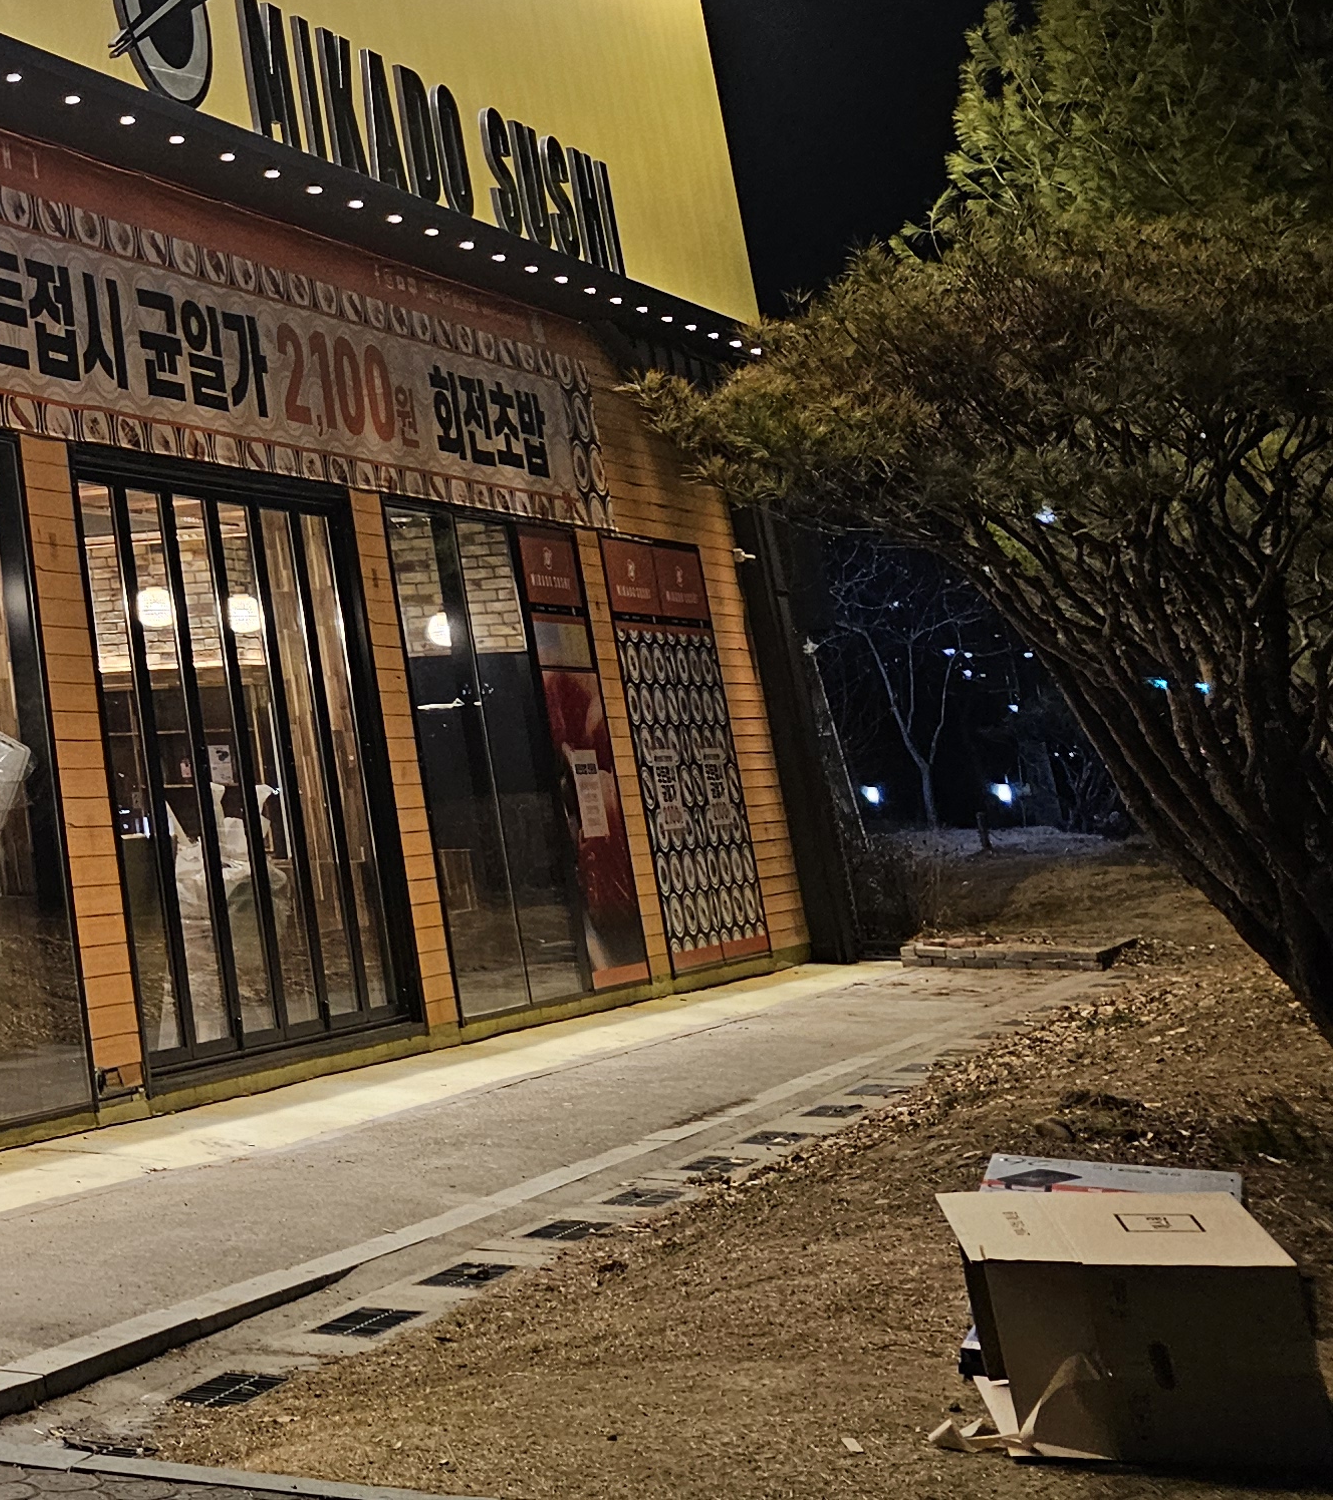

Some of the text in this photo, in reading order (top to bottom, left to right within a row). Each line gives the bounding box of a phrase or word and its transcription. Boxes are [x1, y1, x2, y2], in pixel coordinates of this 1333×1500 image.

[478, 107, 626, 278] SUSHI
[136, 287, 269, 418] 균일가
[427, 363, 552, 479] 회전초밥
